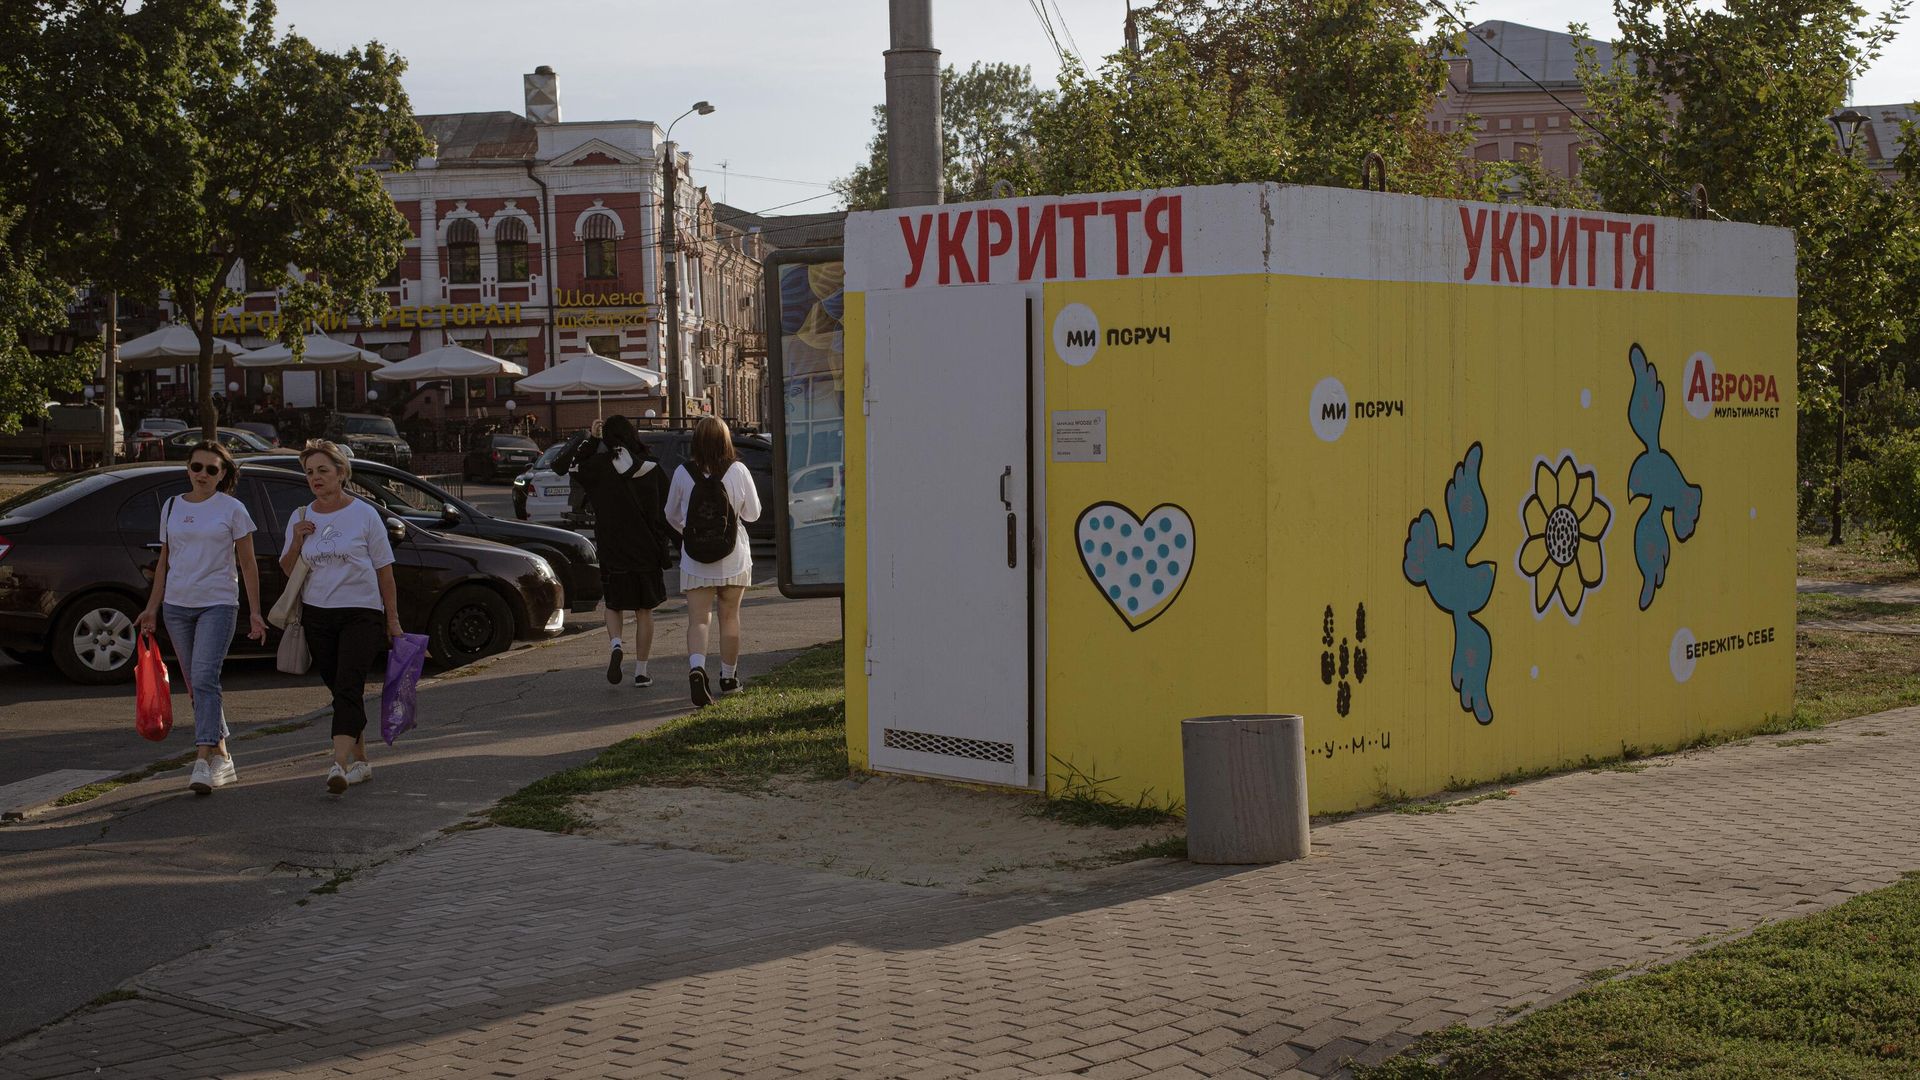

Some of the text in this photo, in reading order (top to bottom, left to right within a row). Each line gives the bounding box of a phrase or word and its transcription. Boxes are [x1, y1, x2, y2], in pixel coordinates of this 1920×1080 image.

[898, 195, 1183, 288] УКРИТТЯ
[1458, 206, 1655, 290] УКРИТТЯ
[555, 288, 646, 307] Шалена
[381, 303, 521, 328] РЕСТОРАН
[1066, 326, 1171, 347] МИ ПОРУЧ
[1321, 400, 1404, 420] МИ ПОРУЧ
[1714, 407, 1780, 418] МУЛЬТИМАРКЕТ
[1686, 627, 1775, 660] БЕРЕЖІТЬ СЕБЕ
